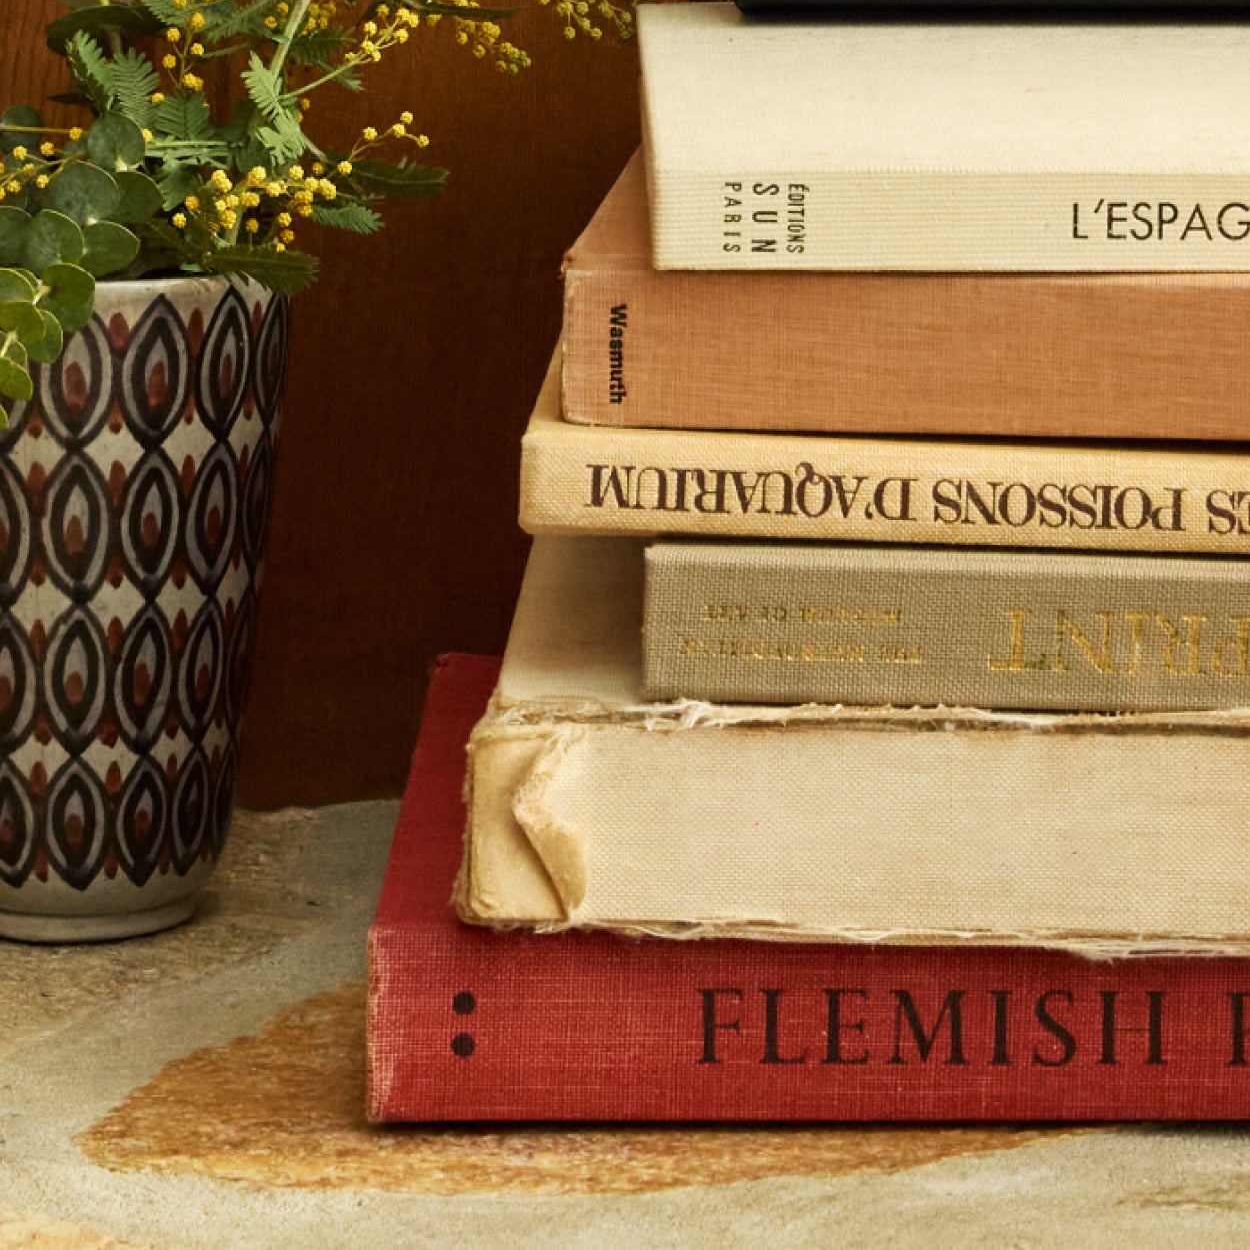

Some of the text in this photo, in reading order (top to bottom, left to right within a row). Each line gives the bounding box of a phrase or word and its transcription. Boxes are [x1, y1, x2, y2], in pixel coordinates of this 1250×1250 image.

[723, 182, 742, 253] PARIS
[751, 182, 780, 253] SUN
[609, 303, 628, 405] Wasmuth
[585, 461, 919, 523] D'AQUARIUM
[932, 478, 1187, 533] POISSONS
[697, 985, 1166, 1068] FLEMISH
